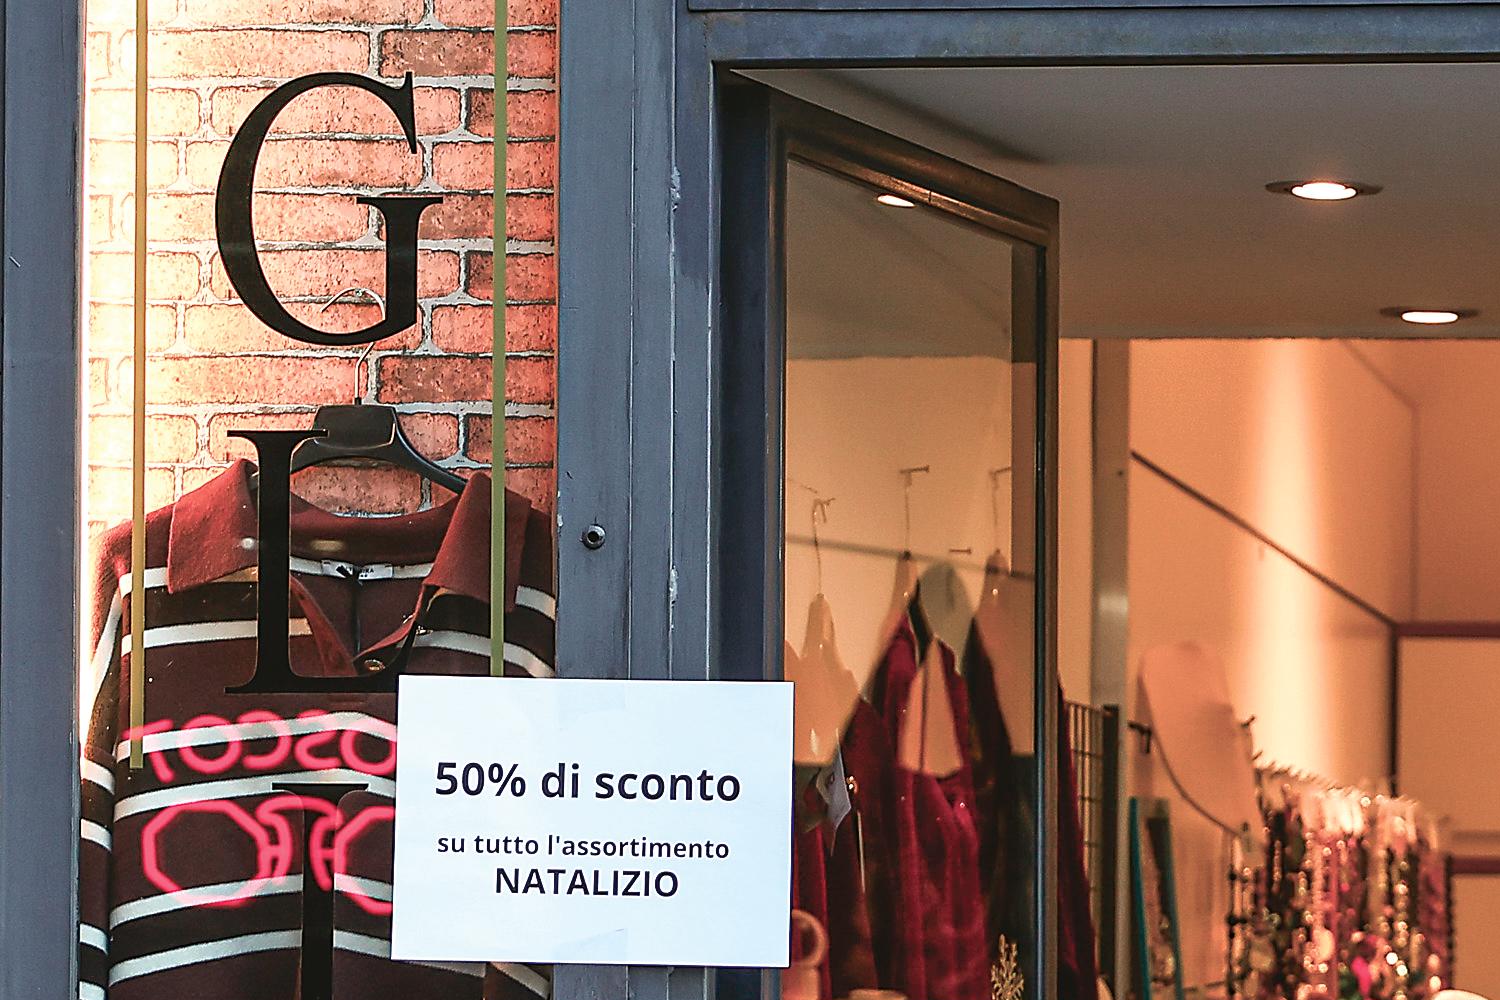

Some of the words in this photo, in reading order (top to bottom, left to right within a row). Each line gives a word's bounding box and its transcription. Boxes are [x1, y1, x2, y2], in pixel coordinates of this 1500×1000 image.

[435, 761, 526, 798] 50%
[541, 762, 580, 799] di
[595, 769, 741, 802] sconto
[437, 837, 465, 853] su
[473, 835, 539, 855] tutto
[548, 834, 729, 859] l'assortimento
[495, 867, 679, 898] NATALIZIO
